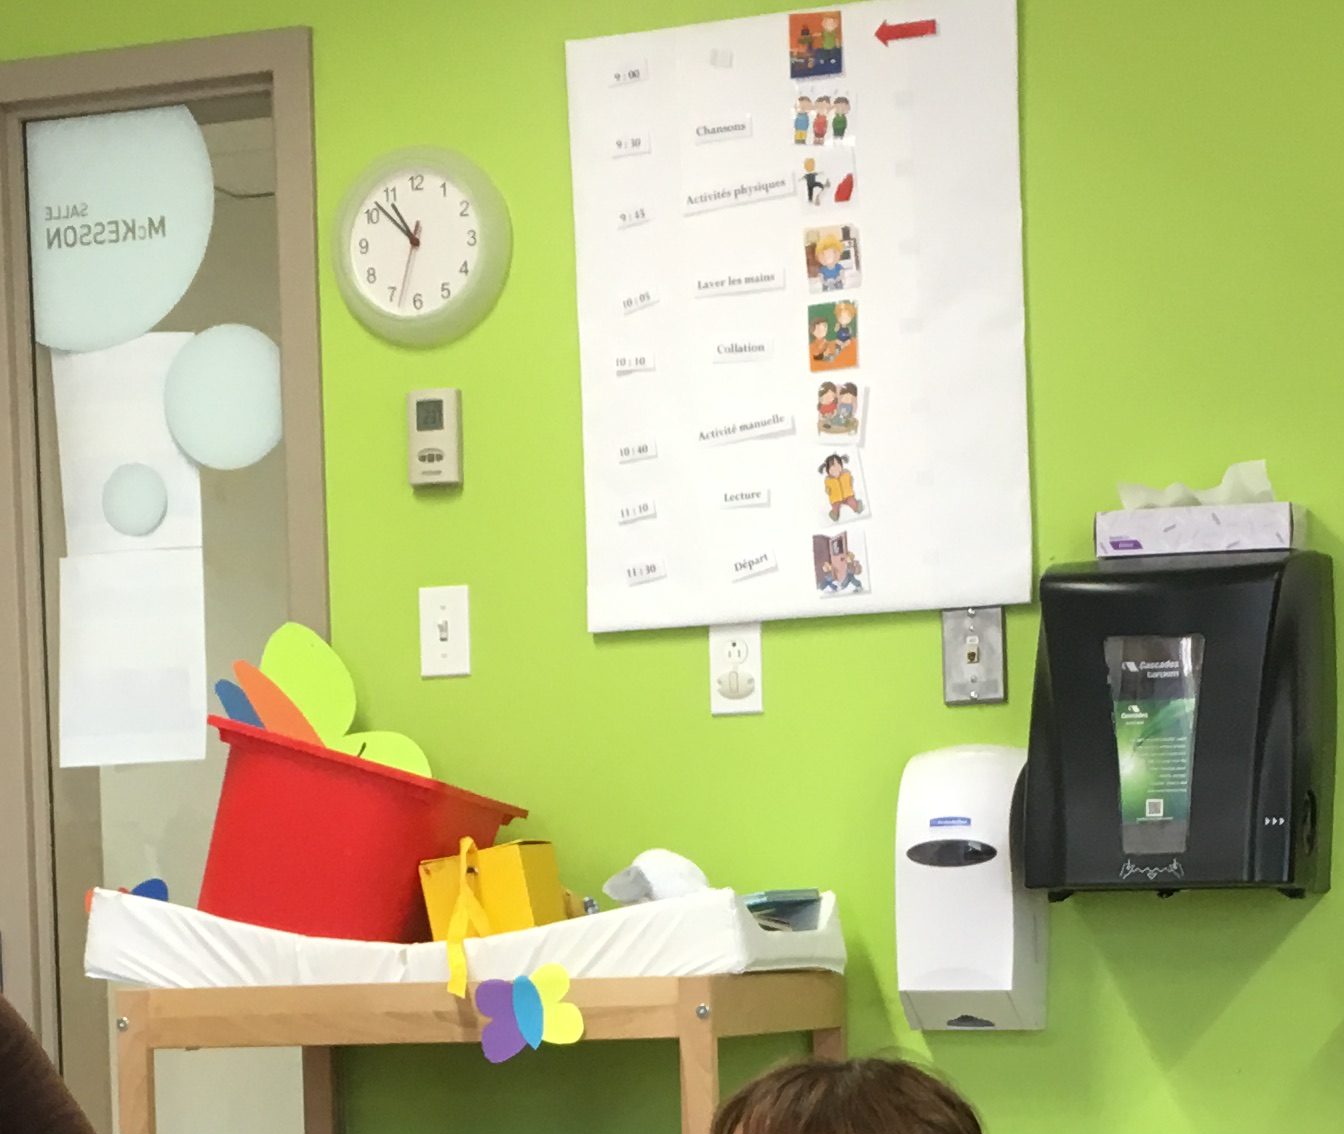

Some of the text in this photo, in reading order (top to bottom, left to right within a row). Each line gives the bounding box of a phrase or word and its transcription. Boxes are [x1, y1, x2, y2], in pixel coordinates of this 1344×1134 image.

[696, 123, 746, 136] Chansons
[408, 174, 424, 191] 12
[440, 182, 447, 197] 1
[734, 179, 786, 199] physiques
[384, 187, 397, 202] 11
[365, 208, 380, 224] 10
[459, 201, 469, 217] 2
[467, 230, 477, 246] 3
[359, 239, 369, 255] 9
[367, 267, 377, 284] 8
[459, 260, 469, 276] 4
[697, 273, 775, 290] Laver les mains
[387, 287, 397, 302] 7
[441, 282, 451, 299] 5
[413, 293, 423, 310] 6
[717, 342, 765, 354] Collation
[699, 414, 785, 441] Activité manuelle
[724, 491, 762, 503] Lecture
[734, 553, 768, 572] Départ
